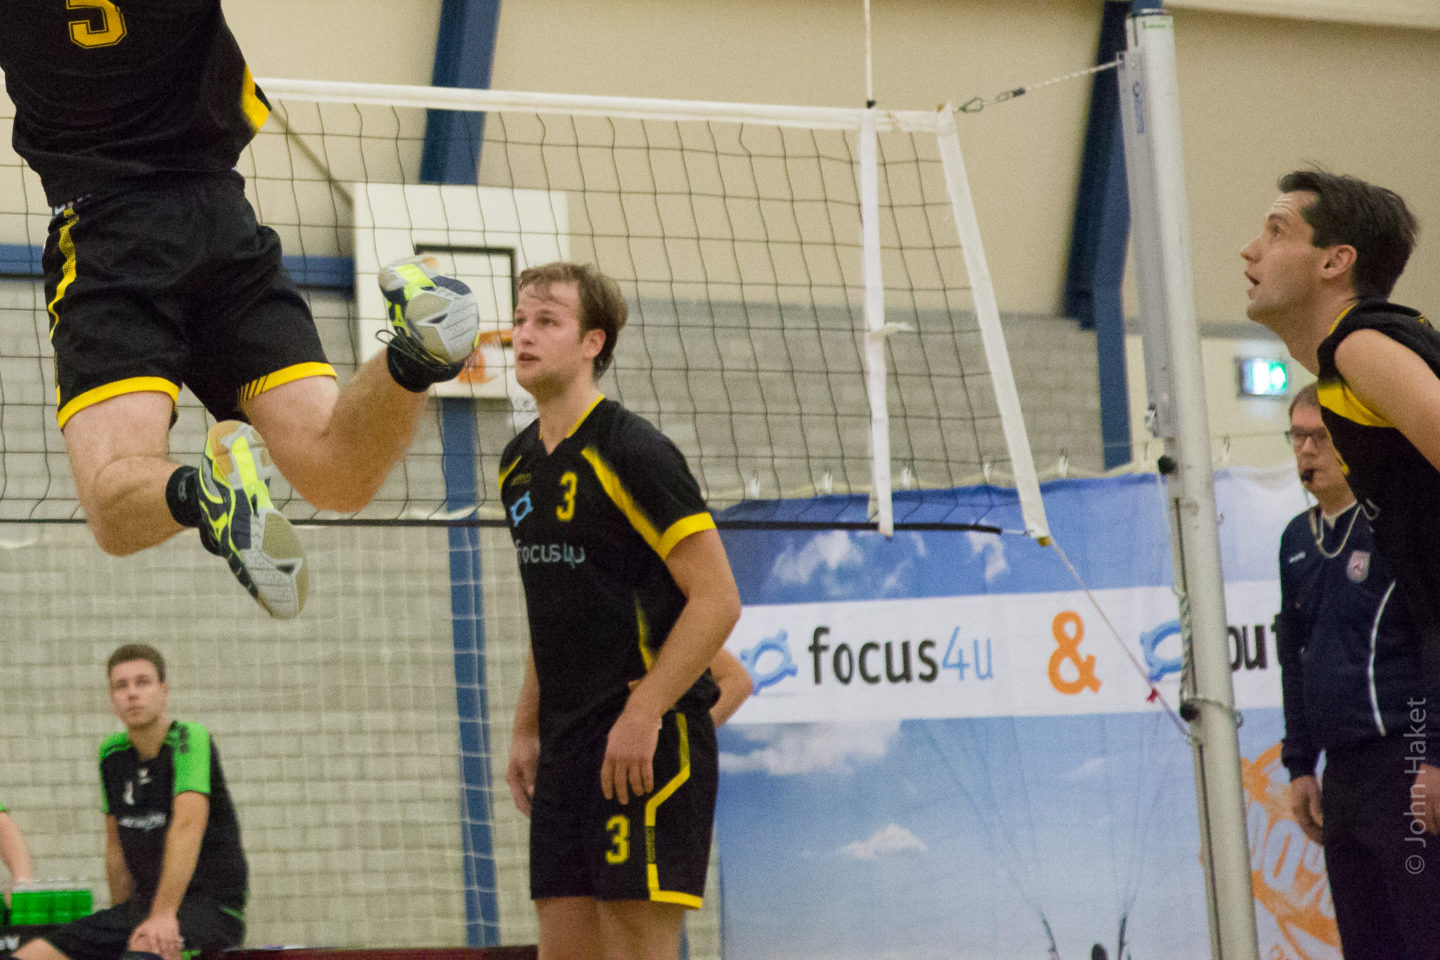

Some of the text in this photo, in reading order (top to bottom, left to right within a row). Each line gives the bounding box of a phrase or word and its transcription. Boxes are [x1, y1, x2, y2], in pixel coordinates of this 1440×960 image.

[556, 471, 578, 522] 3
[809, 625, 994, 685] focus4u
[1048, 610, 1102, 696] &
[605, 814, 631, 865] 3
